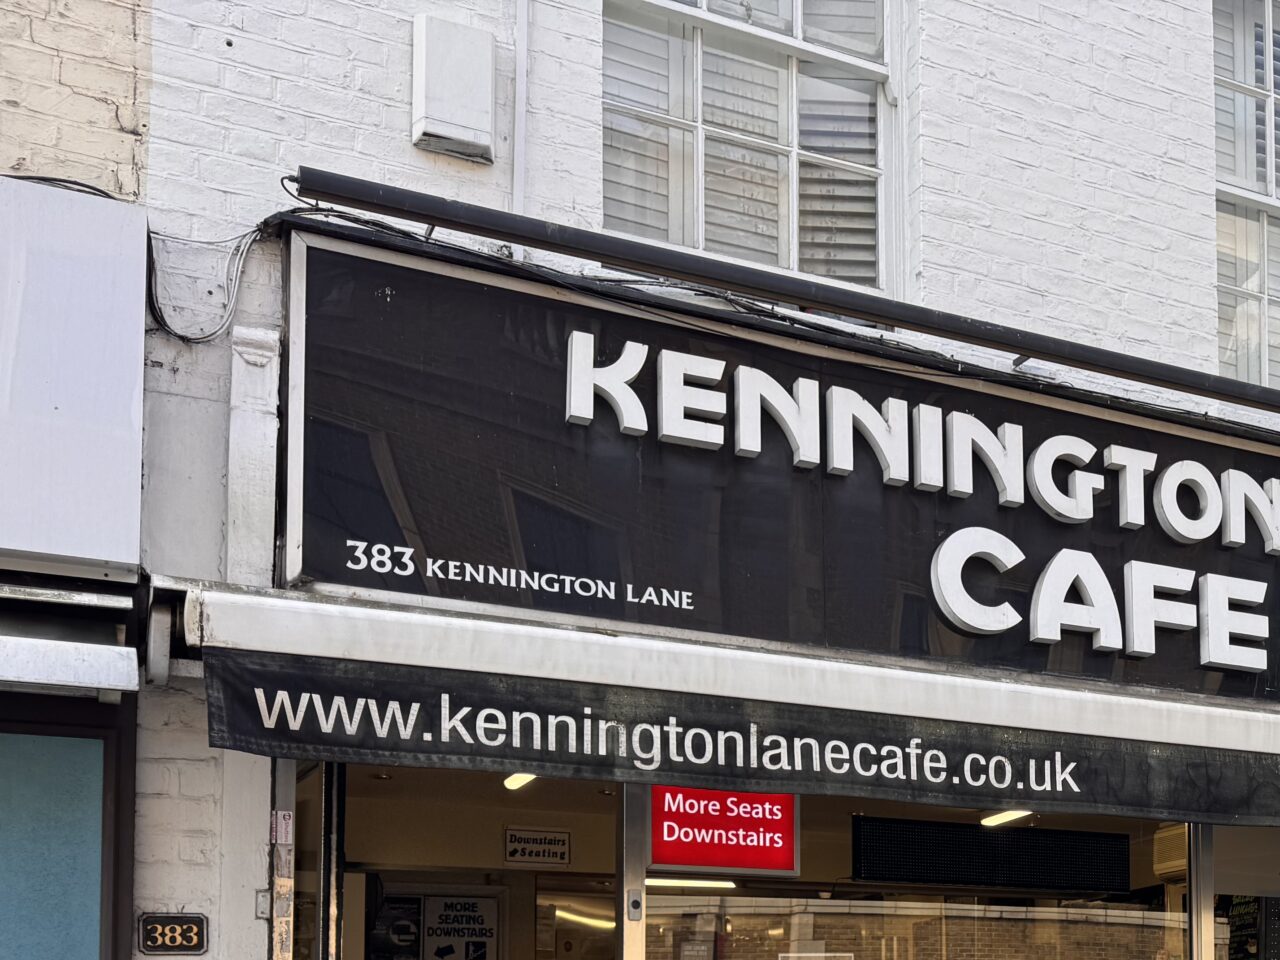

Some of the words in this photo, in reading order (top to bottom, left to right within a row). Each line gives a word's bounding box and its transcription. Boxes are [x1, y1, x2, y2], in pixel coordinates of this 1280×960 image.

[345, 539, 415, 577] 383
[425, 557, 616, 600] KENNINGTON
[626, 582, 695, 610] LANE
[930, 526, 1269, 674] CAFE
[253, 686, 1081, 793] www.kenningtonlanecafe.co.uk
[663, 792, 721, 816] More
[726, 796, 783, 821] Seats
[508, 834, 567, 847] Downstairs
[662, 822, 784, 849] Downstairs
[519, 847, 566, 860] Seating
[443, 902, 479, 913] MORE
[437, 914, 485, 926] SEATING
[146, 923, 200, 947] 383
[426, 927, 494, 939] DOWNSTAIRS
